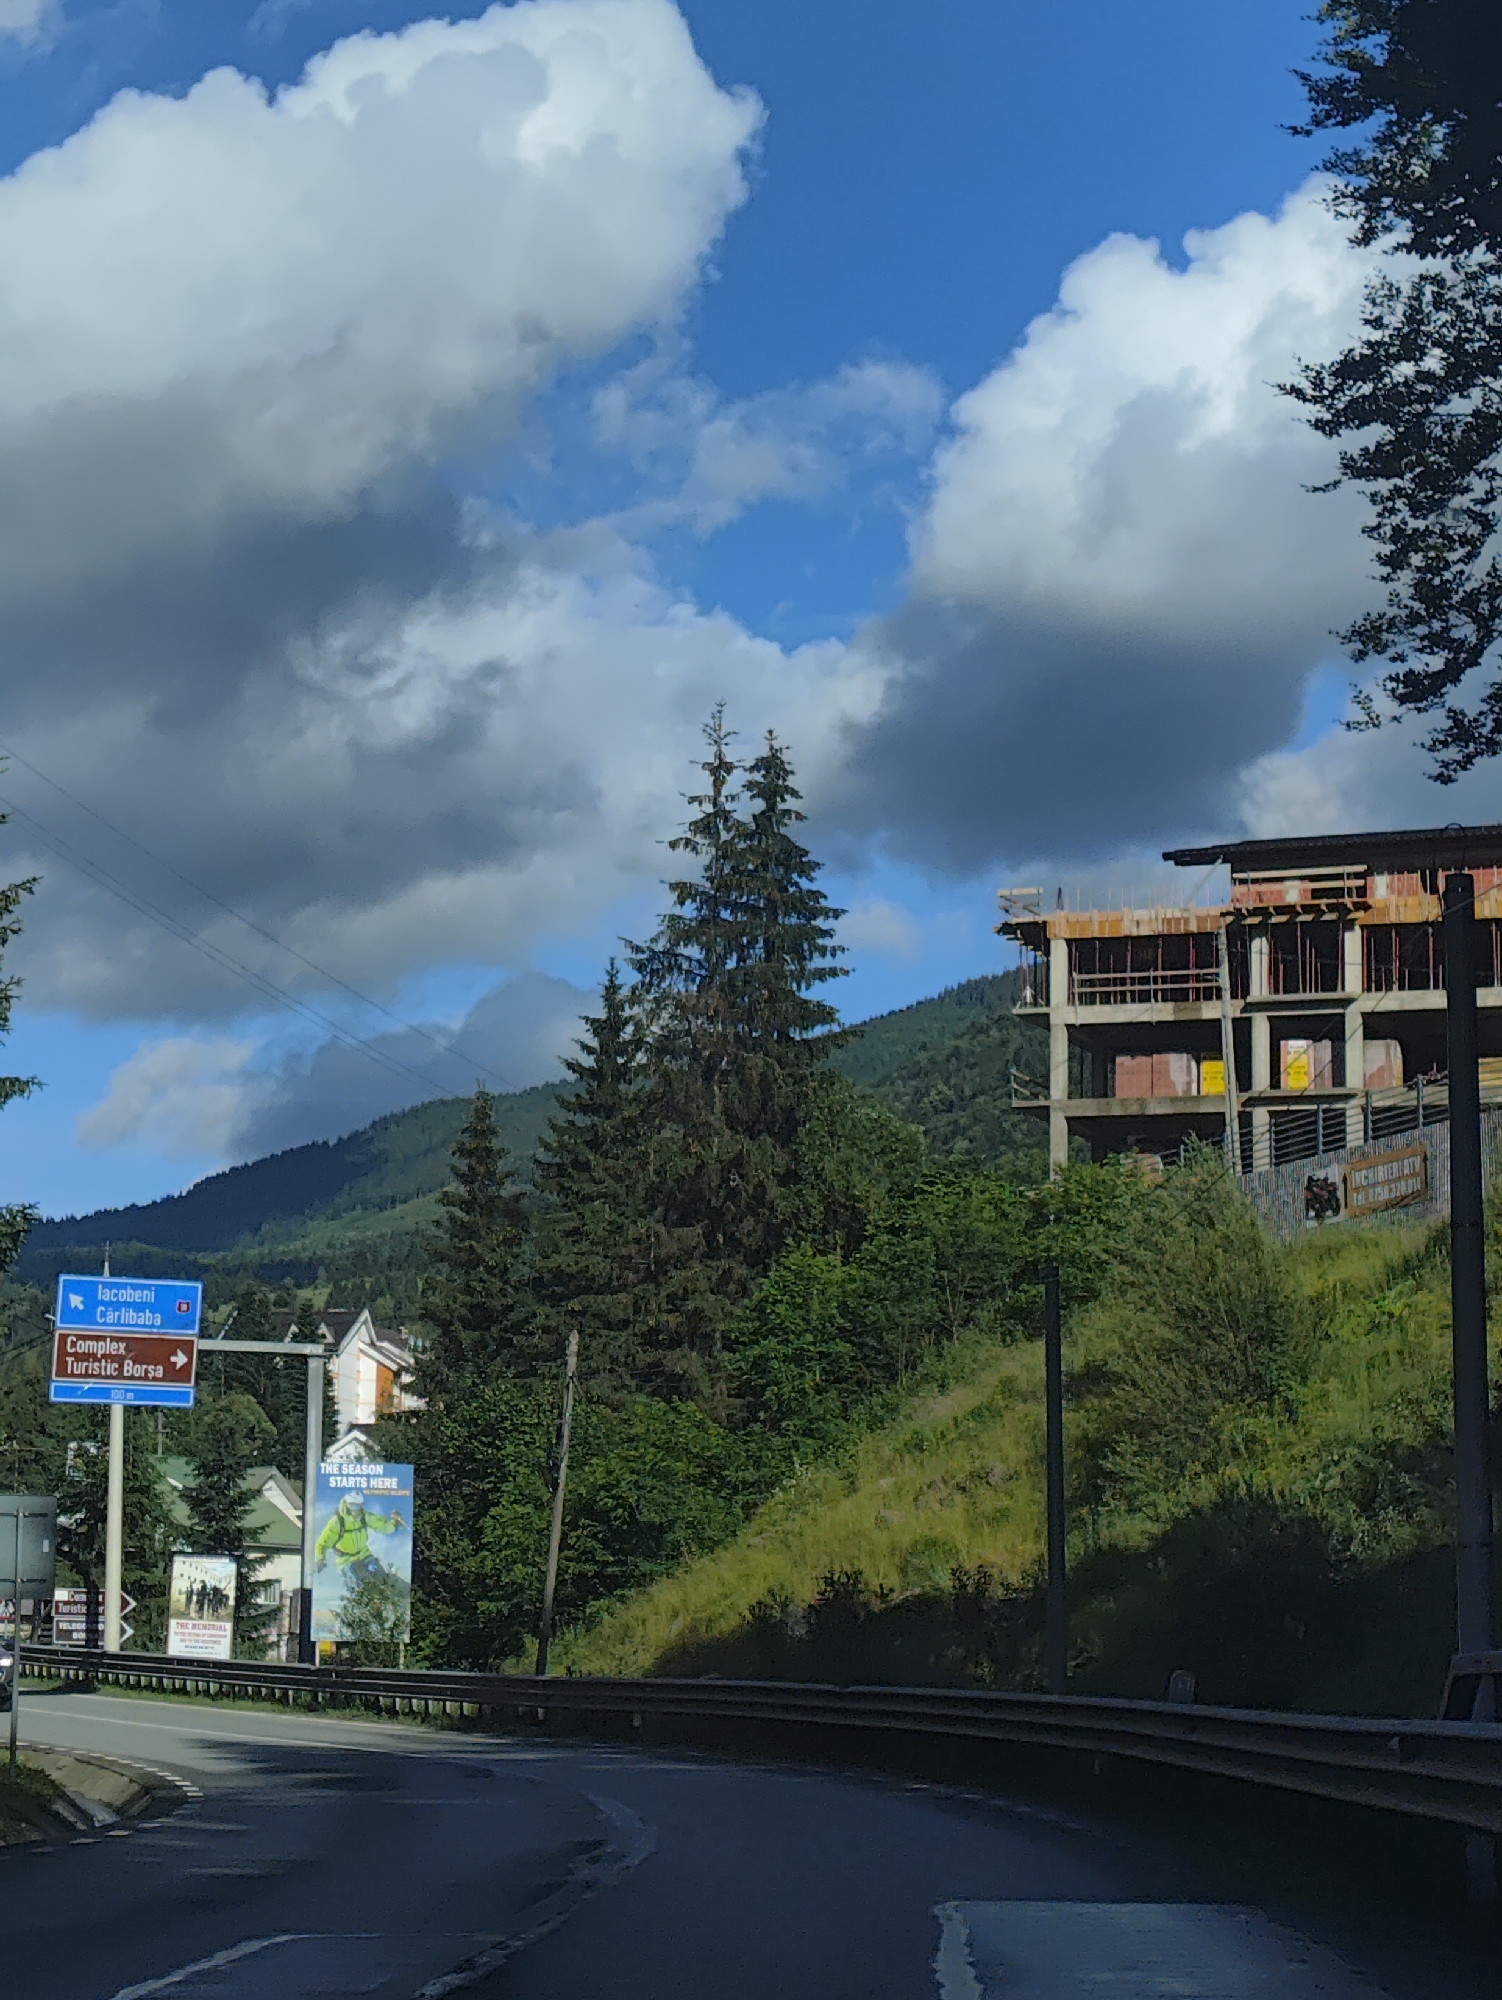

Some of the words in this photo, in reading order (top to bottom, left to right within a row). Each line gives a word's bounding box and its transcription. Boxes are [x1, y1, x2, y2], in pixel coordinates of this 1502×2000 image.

[1403, 1155, 1421, 1177] ATV
[98, 1284, 156, 1303] Iacobeni
[97, 1306, 162, 1326] Cârlibaba
[66, 1335, 127, 1358] Complex
[65, 1356, 119, 1376] Turistic
[111, 1389, 125, 1400] 100
[126, 1392, 134, 1400] m
[320, 1463, 339, 1474] THE
[341, 1463, 384, 1475] SEASON
[329, 1476, 367, 1488] STARTS
[370, 1477, 398, 1489] HERE
[176, 1622, 190, 1630] THE
[191, 1623, 227, 1632] MEMORIAL
